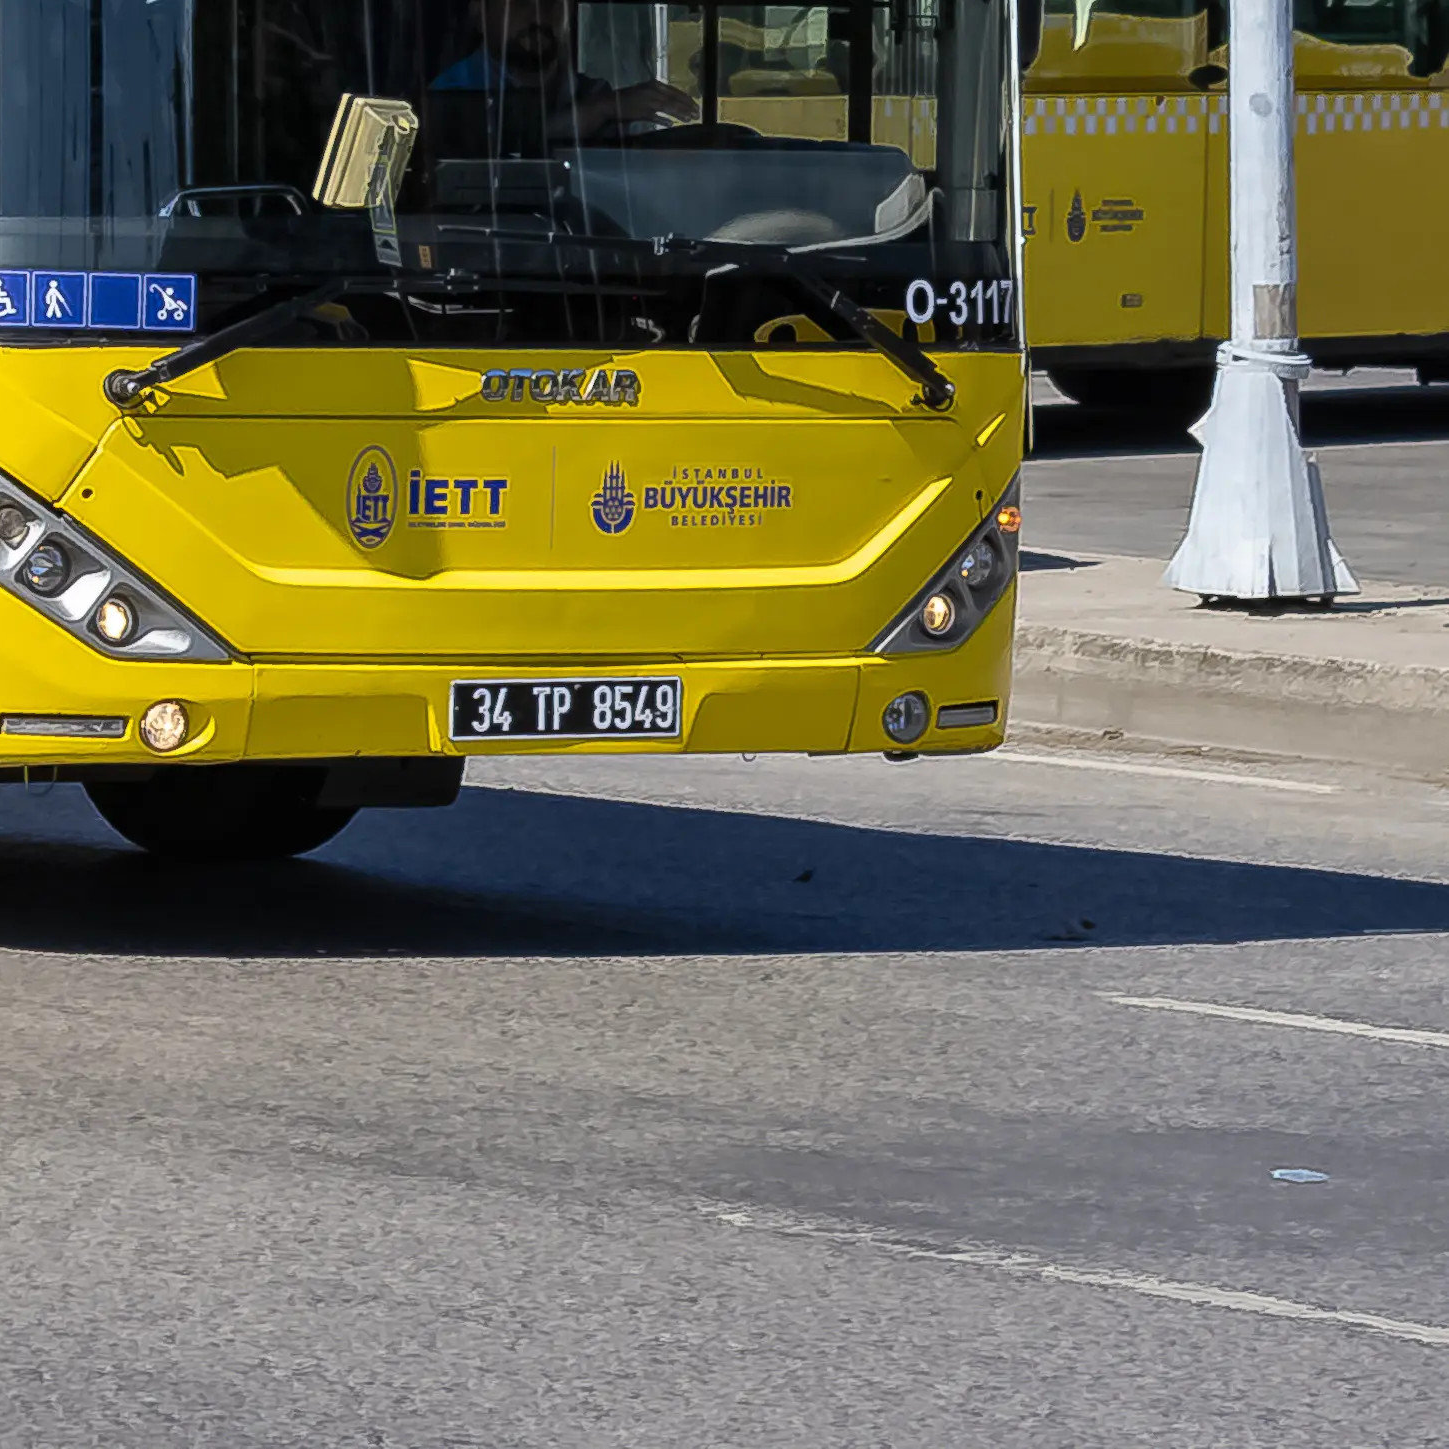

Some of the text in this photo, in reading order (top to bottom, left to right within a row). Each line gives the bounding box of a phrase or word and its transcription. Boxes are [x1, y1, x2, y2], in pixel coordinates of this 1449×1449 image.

[906, 279, 1014, 325] O-3117
[481, 368, 641, 407] OTOKAR
[409, 470, 507, 515] İETT
[672, 466, 764, 480] İSTANBUL
[644, 480, 792, 514] BÜYÜKŞEHİR
[671, 513, 763, 527] BELEDİYESİ
[471, 685, 675, 732] 34 TP 8549
